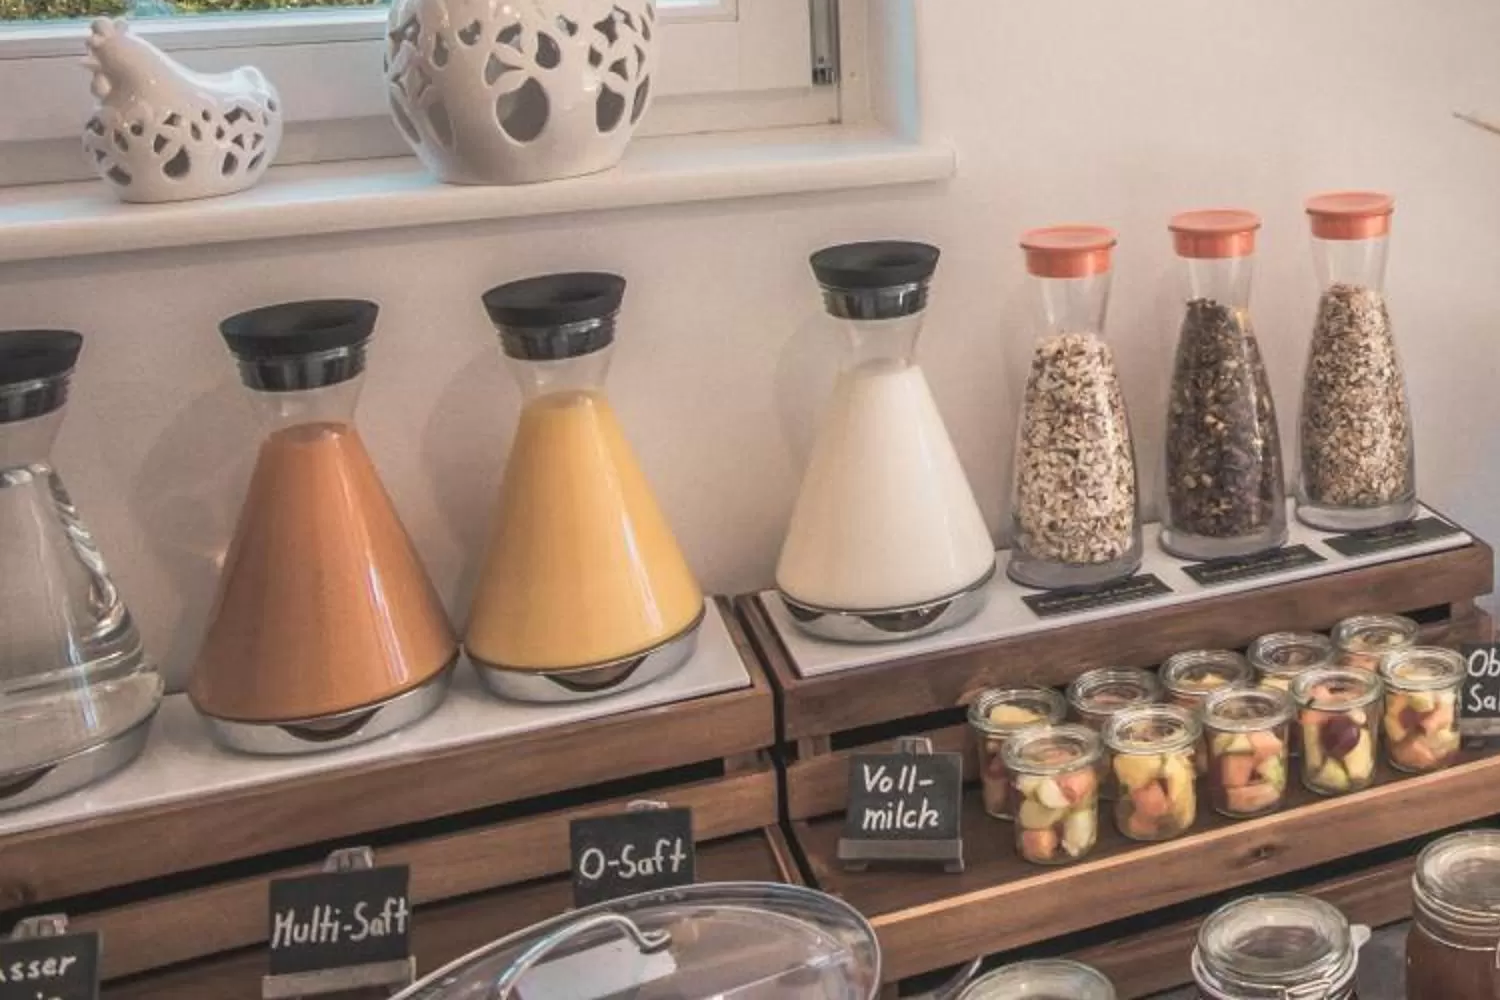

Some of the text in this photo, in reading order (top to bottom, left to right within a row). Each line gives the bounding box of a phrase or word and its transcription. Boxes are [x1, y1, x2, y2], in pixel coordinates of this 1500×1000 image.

[863, 763, 935, 794] Voll-
[862, 797, 939, 831] milch
[580, 837, 687, 880] O-Saft
[271, 896, 409, 949] Multi-Saft
